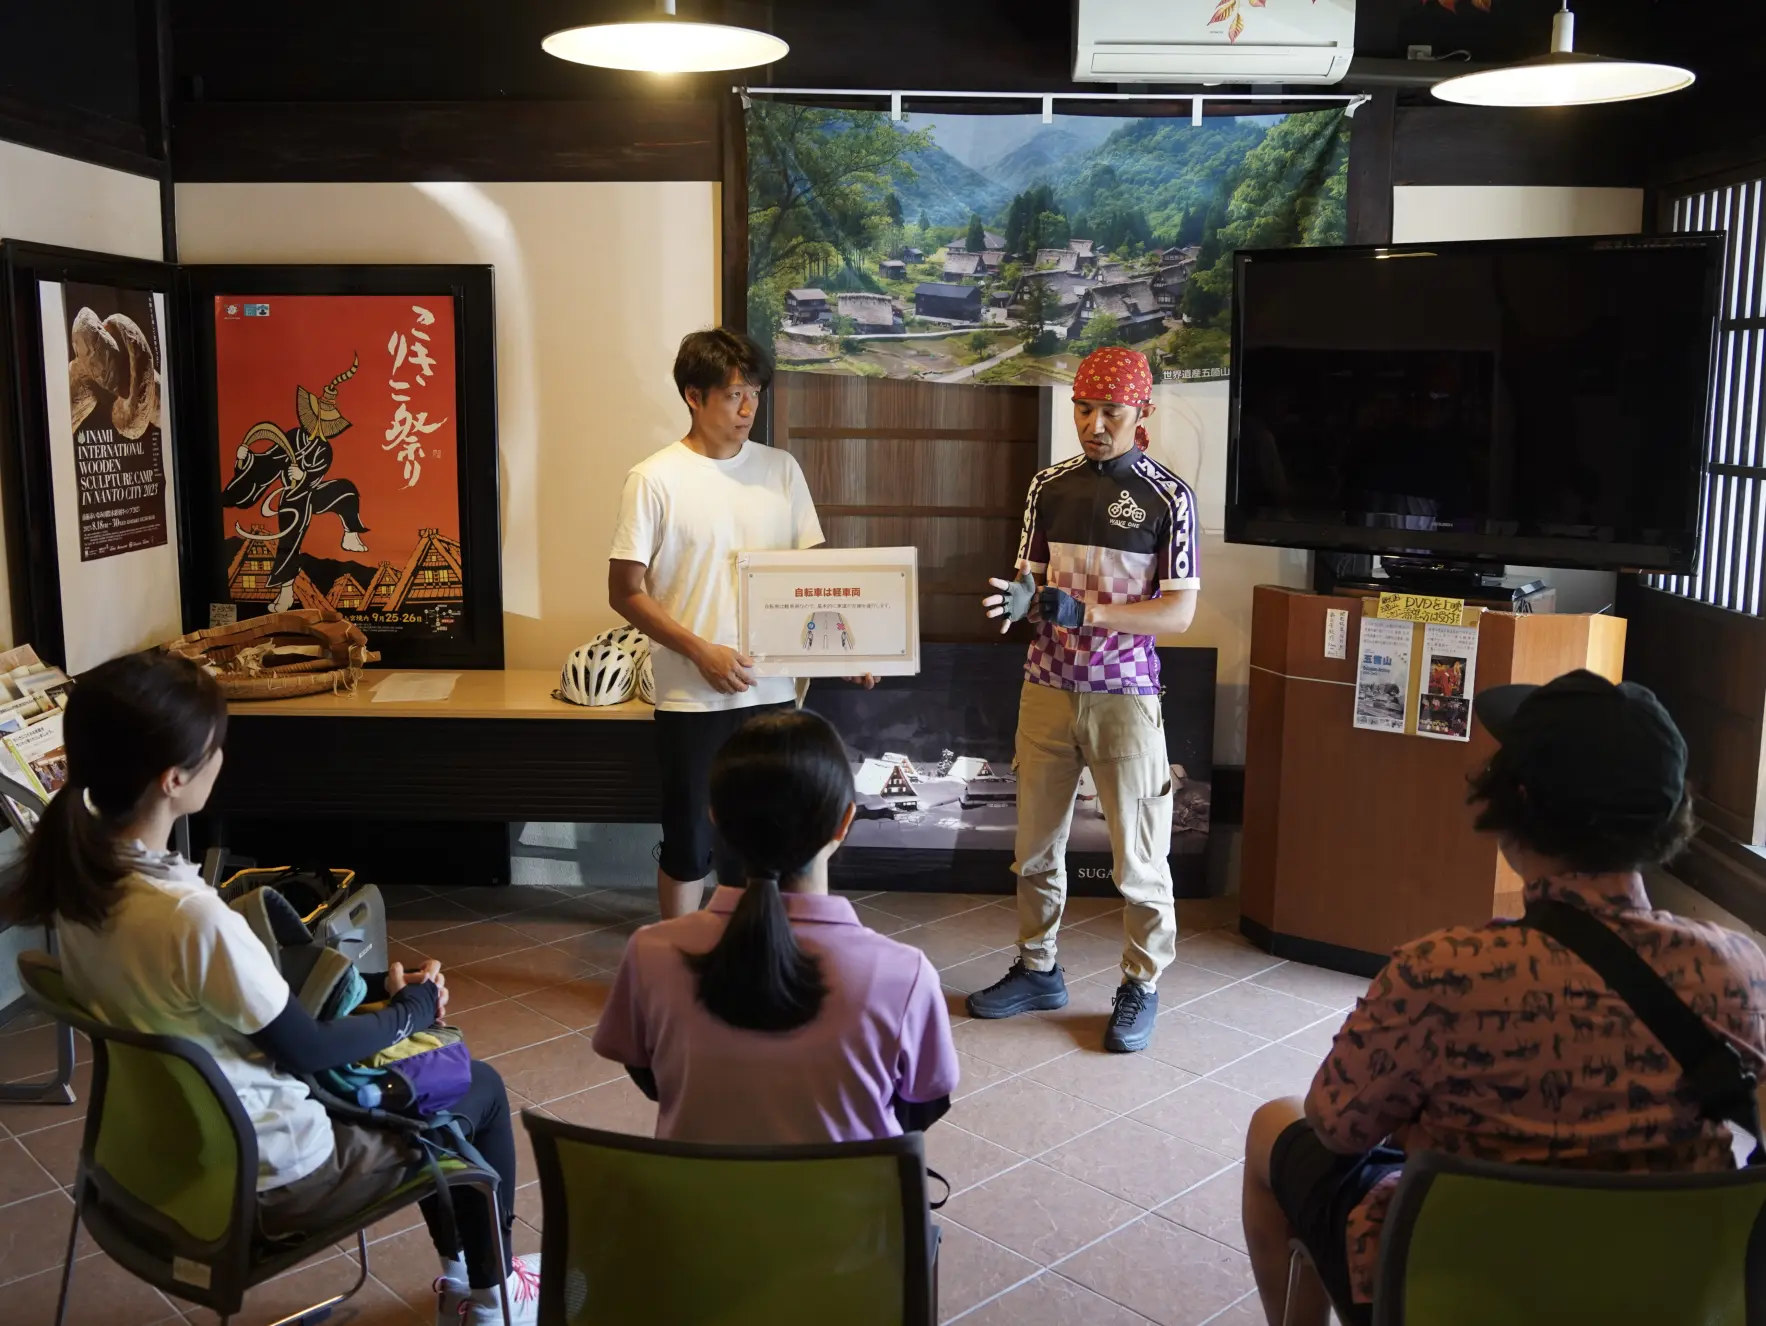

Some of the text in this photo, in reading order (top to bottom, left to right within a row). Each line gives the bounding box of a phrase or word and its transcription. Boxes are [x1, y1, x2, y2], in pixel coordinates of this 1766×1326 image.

[86, 429, 114, 444] INAMI
[78, 442, 145, 460] INTERNATIONAL
[78, 459, 122, 475] WOODEN
[80, 469, 154, 491] SCULPTURE CAMP
[82, 483, 159, 506] IN NANTO CITY 2023
[1109, 518, 1140, 529] WAVE ONE
[1137, 458, 1190, 578] NANTO
[794, 587, 861, 597] 自転車は軽車両
